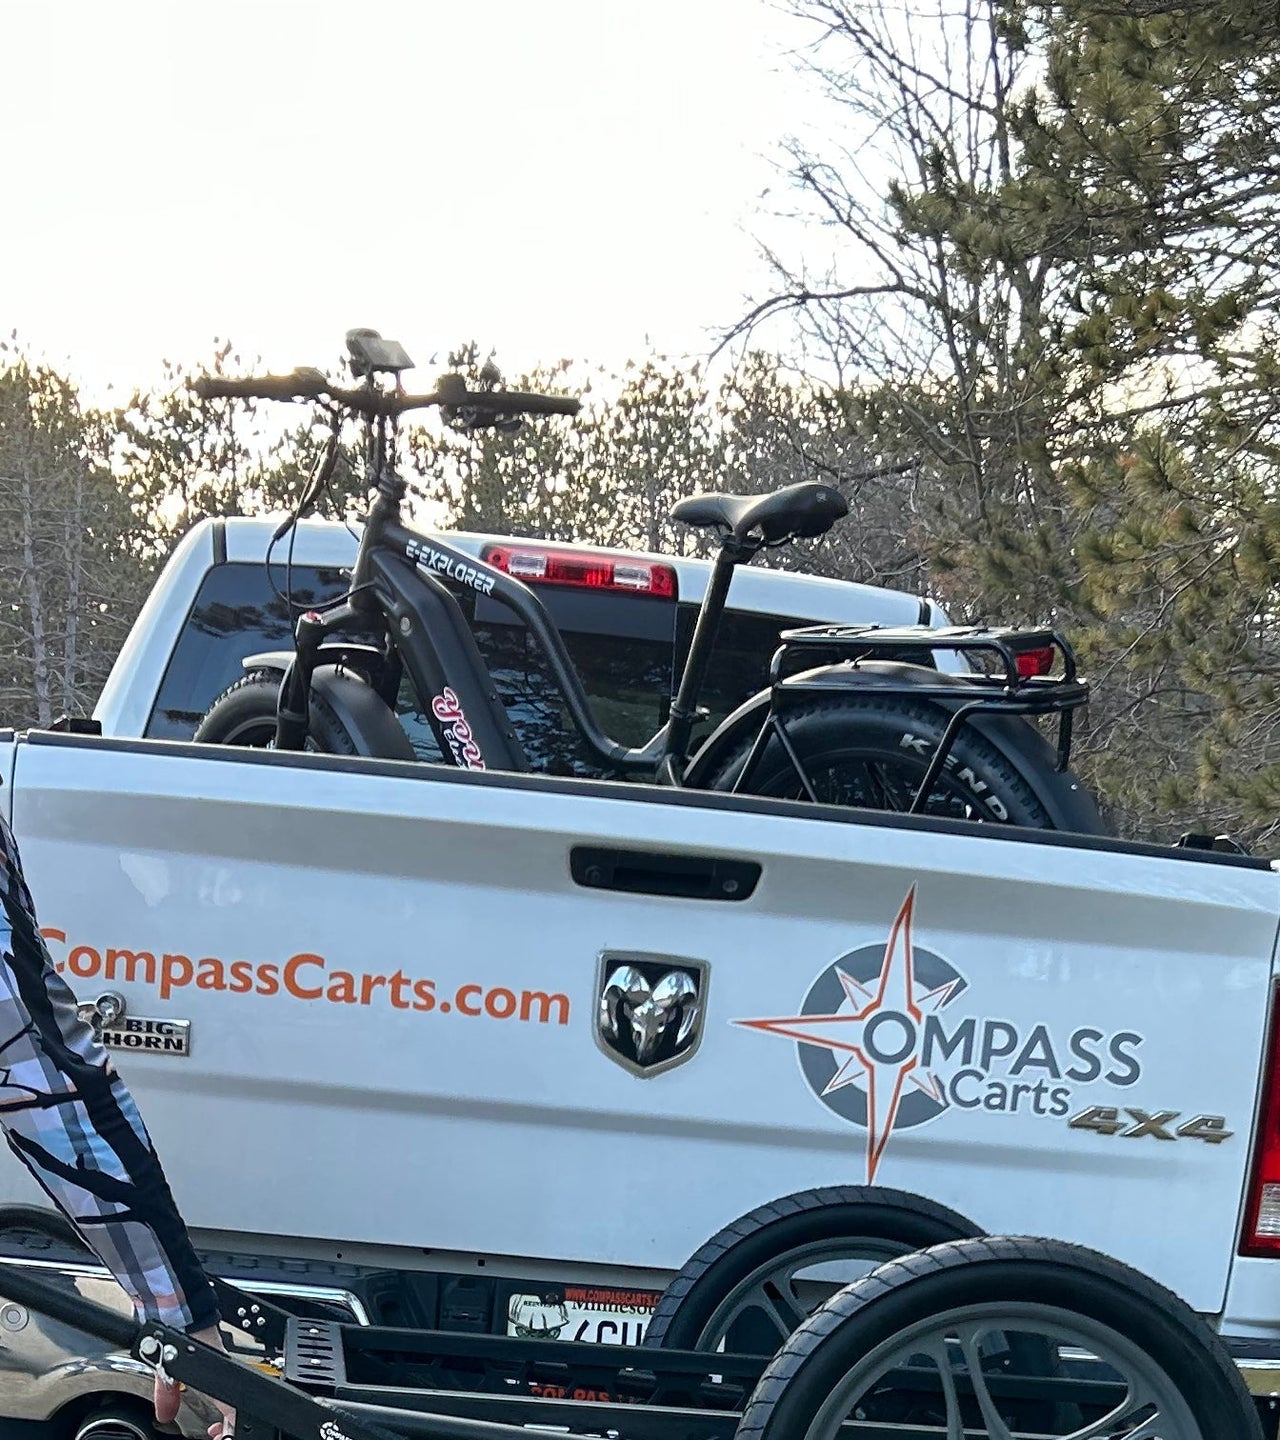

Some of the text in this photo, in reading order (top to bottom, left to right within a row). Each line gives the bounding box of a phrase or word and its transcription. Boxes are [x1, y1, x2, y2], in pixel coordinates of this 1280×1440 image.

[405, 539, 496, 597] E-EXPLORER
[103, 1032, 183, 1050] HORN
[126, 1019, 174, 1035] BIG
[948, 1069, 1071, 1117] Carts
